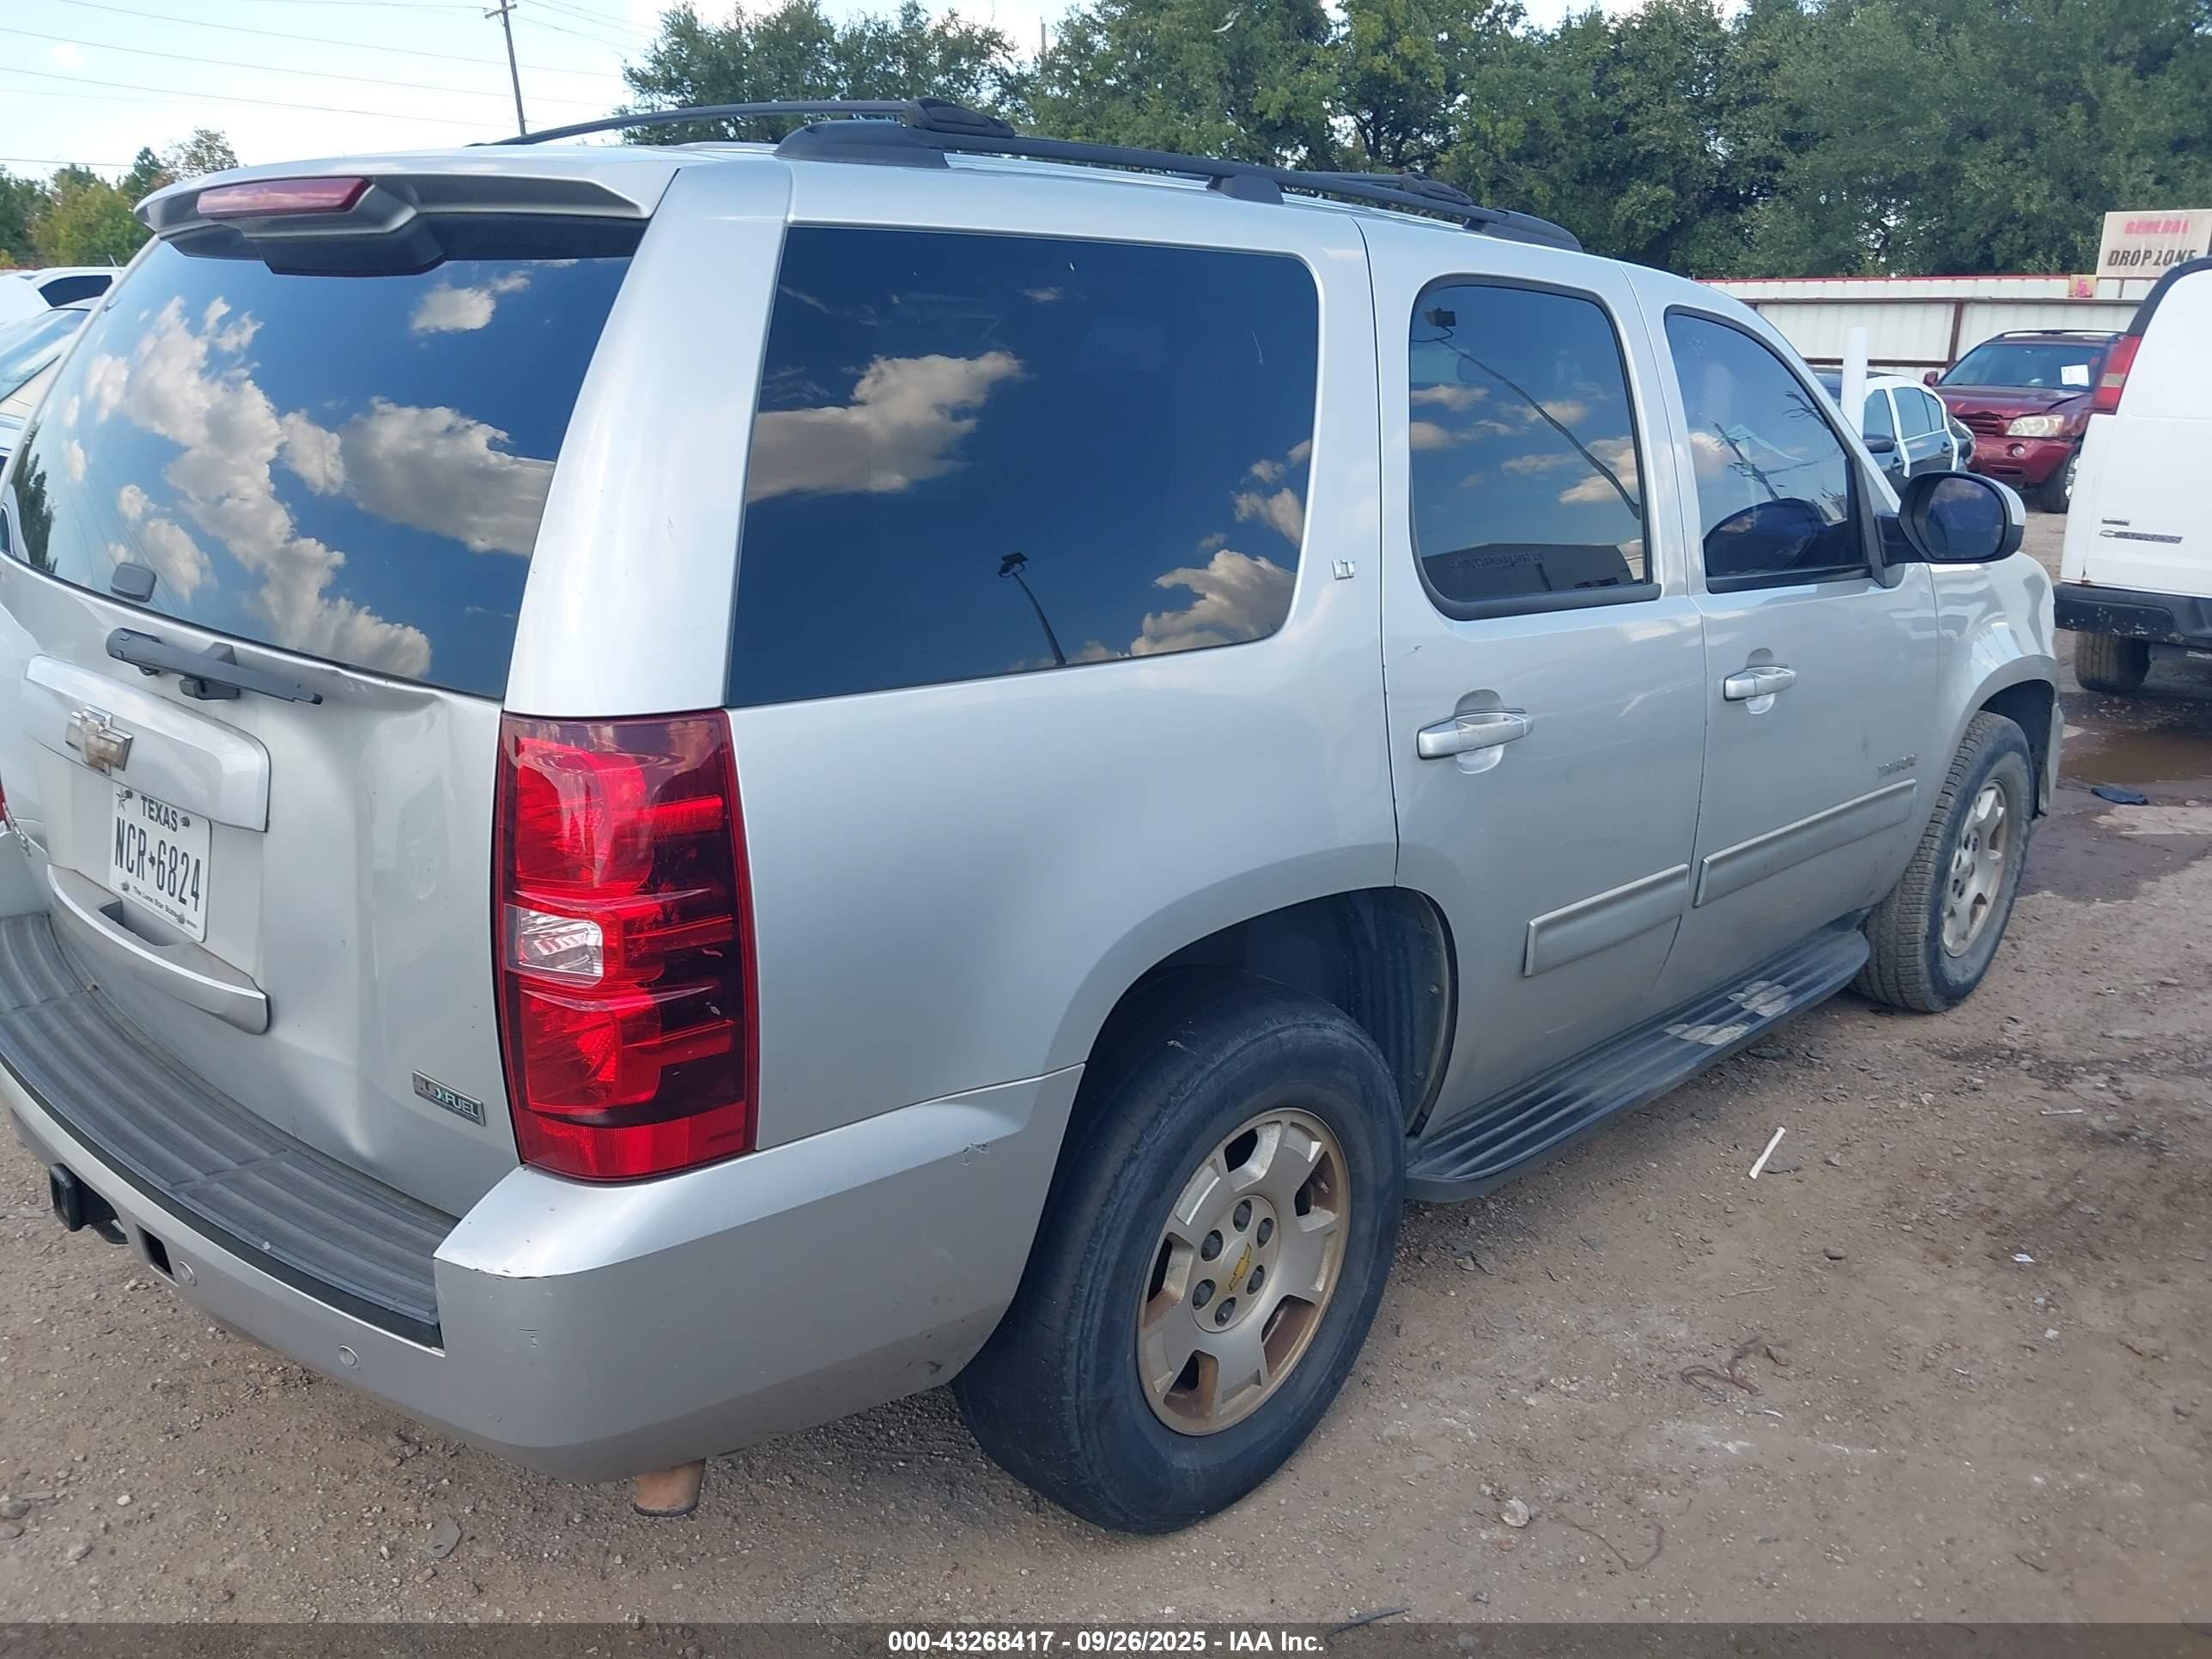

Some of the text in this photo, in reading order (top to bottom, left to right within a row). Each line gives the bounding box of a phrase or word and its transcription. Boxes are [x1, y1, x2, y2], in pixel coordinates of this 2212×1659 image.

[2124, 219, 2190, 234] GENERAL
[2106, 249, 2197, 267] DROP ZONE
[140, 794, 179, 833] TEXAS
